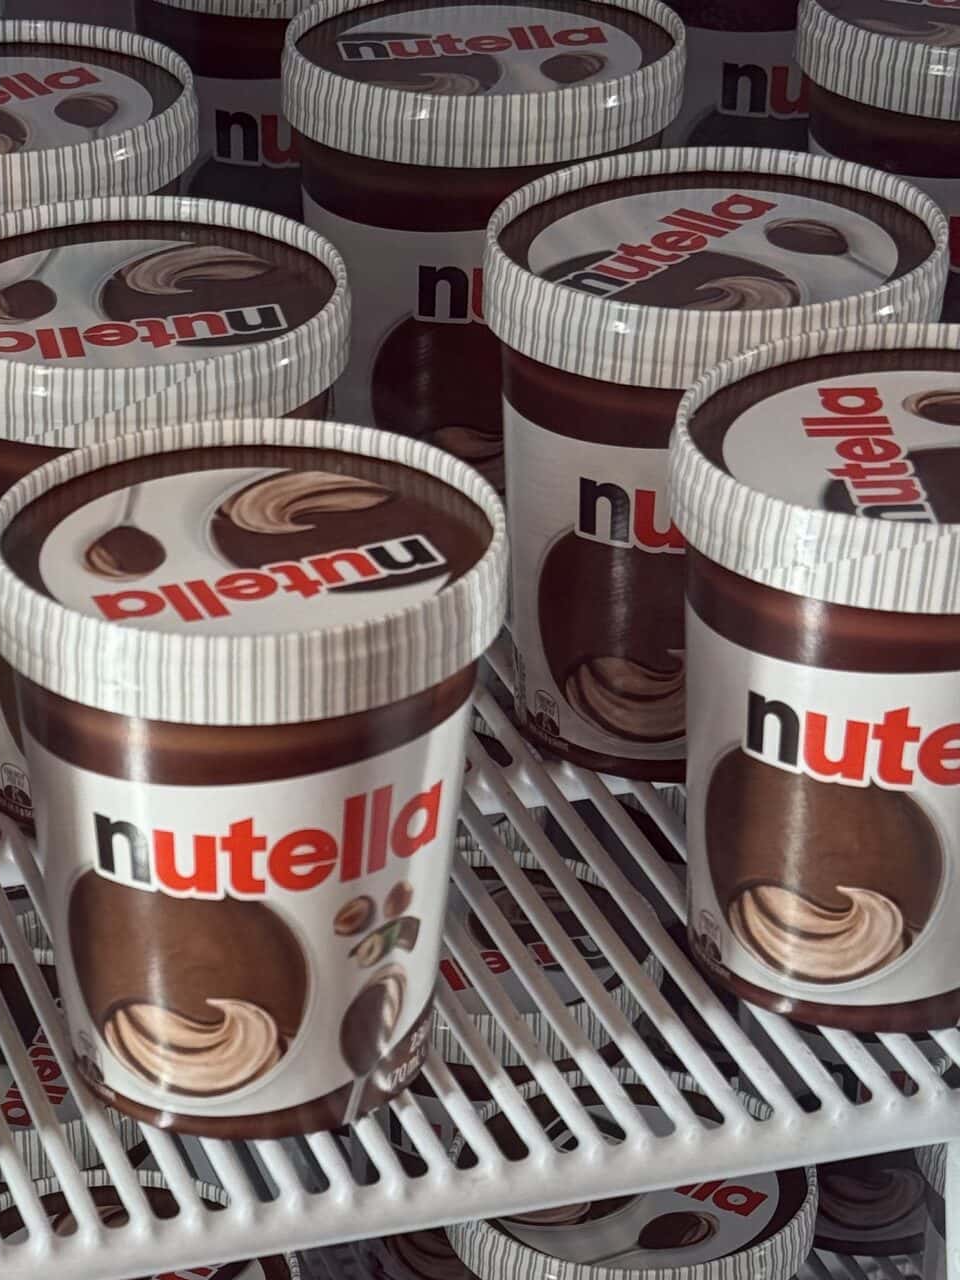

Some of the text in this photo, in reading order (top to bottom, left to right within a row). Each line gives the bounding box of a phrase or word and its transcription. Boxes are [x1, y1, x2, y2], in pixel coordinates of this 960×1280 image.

[341, 25, 608, 60] nutella
[93, 537, 444, 622] nutella
[747, 690, 960, 787] nute
[94, 781, 442, 895] nutella
